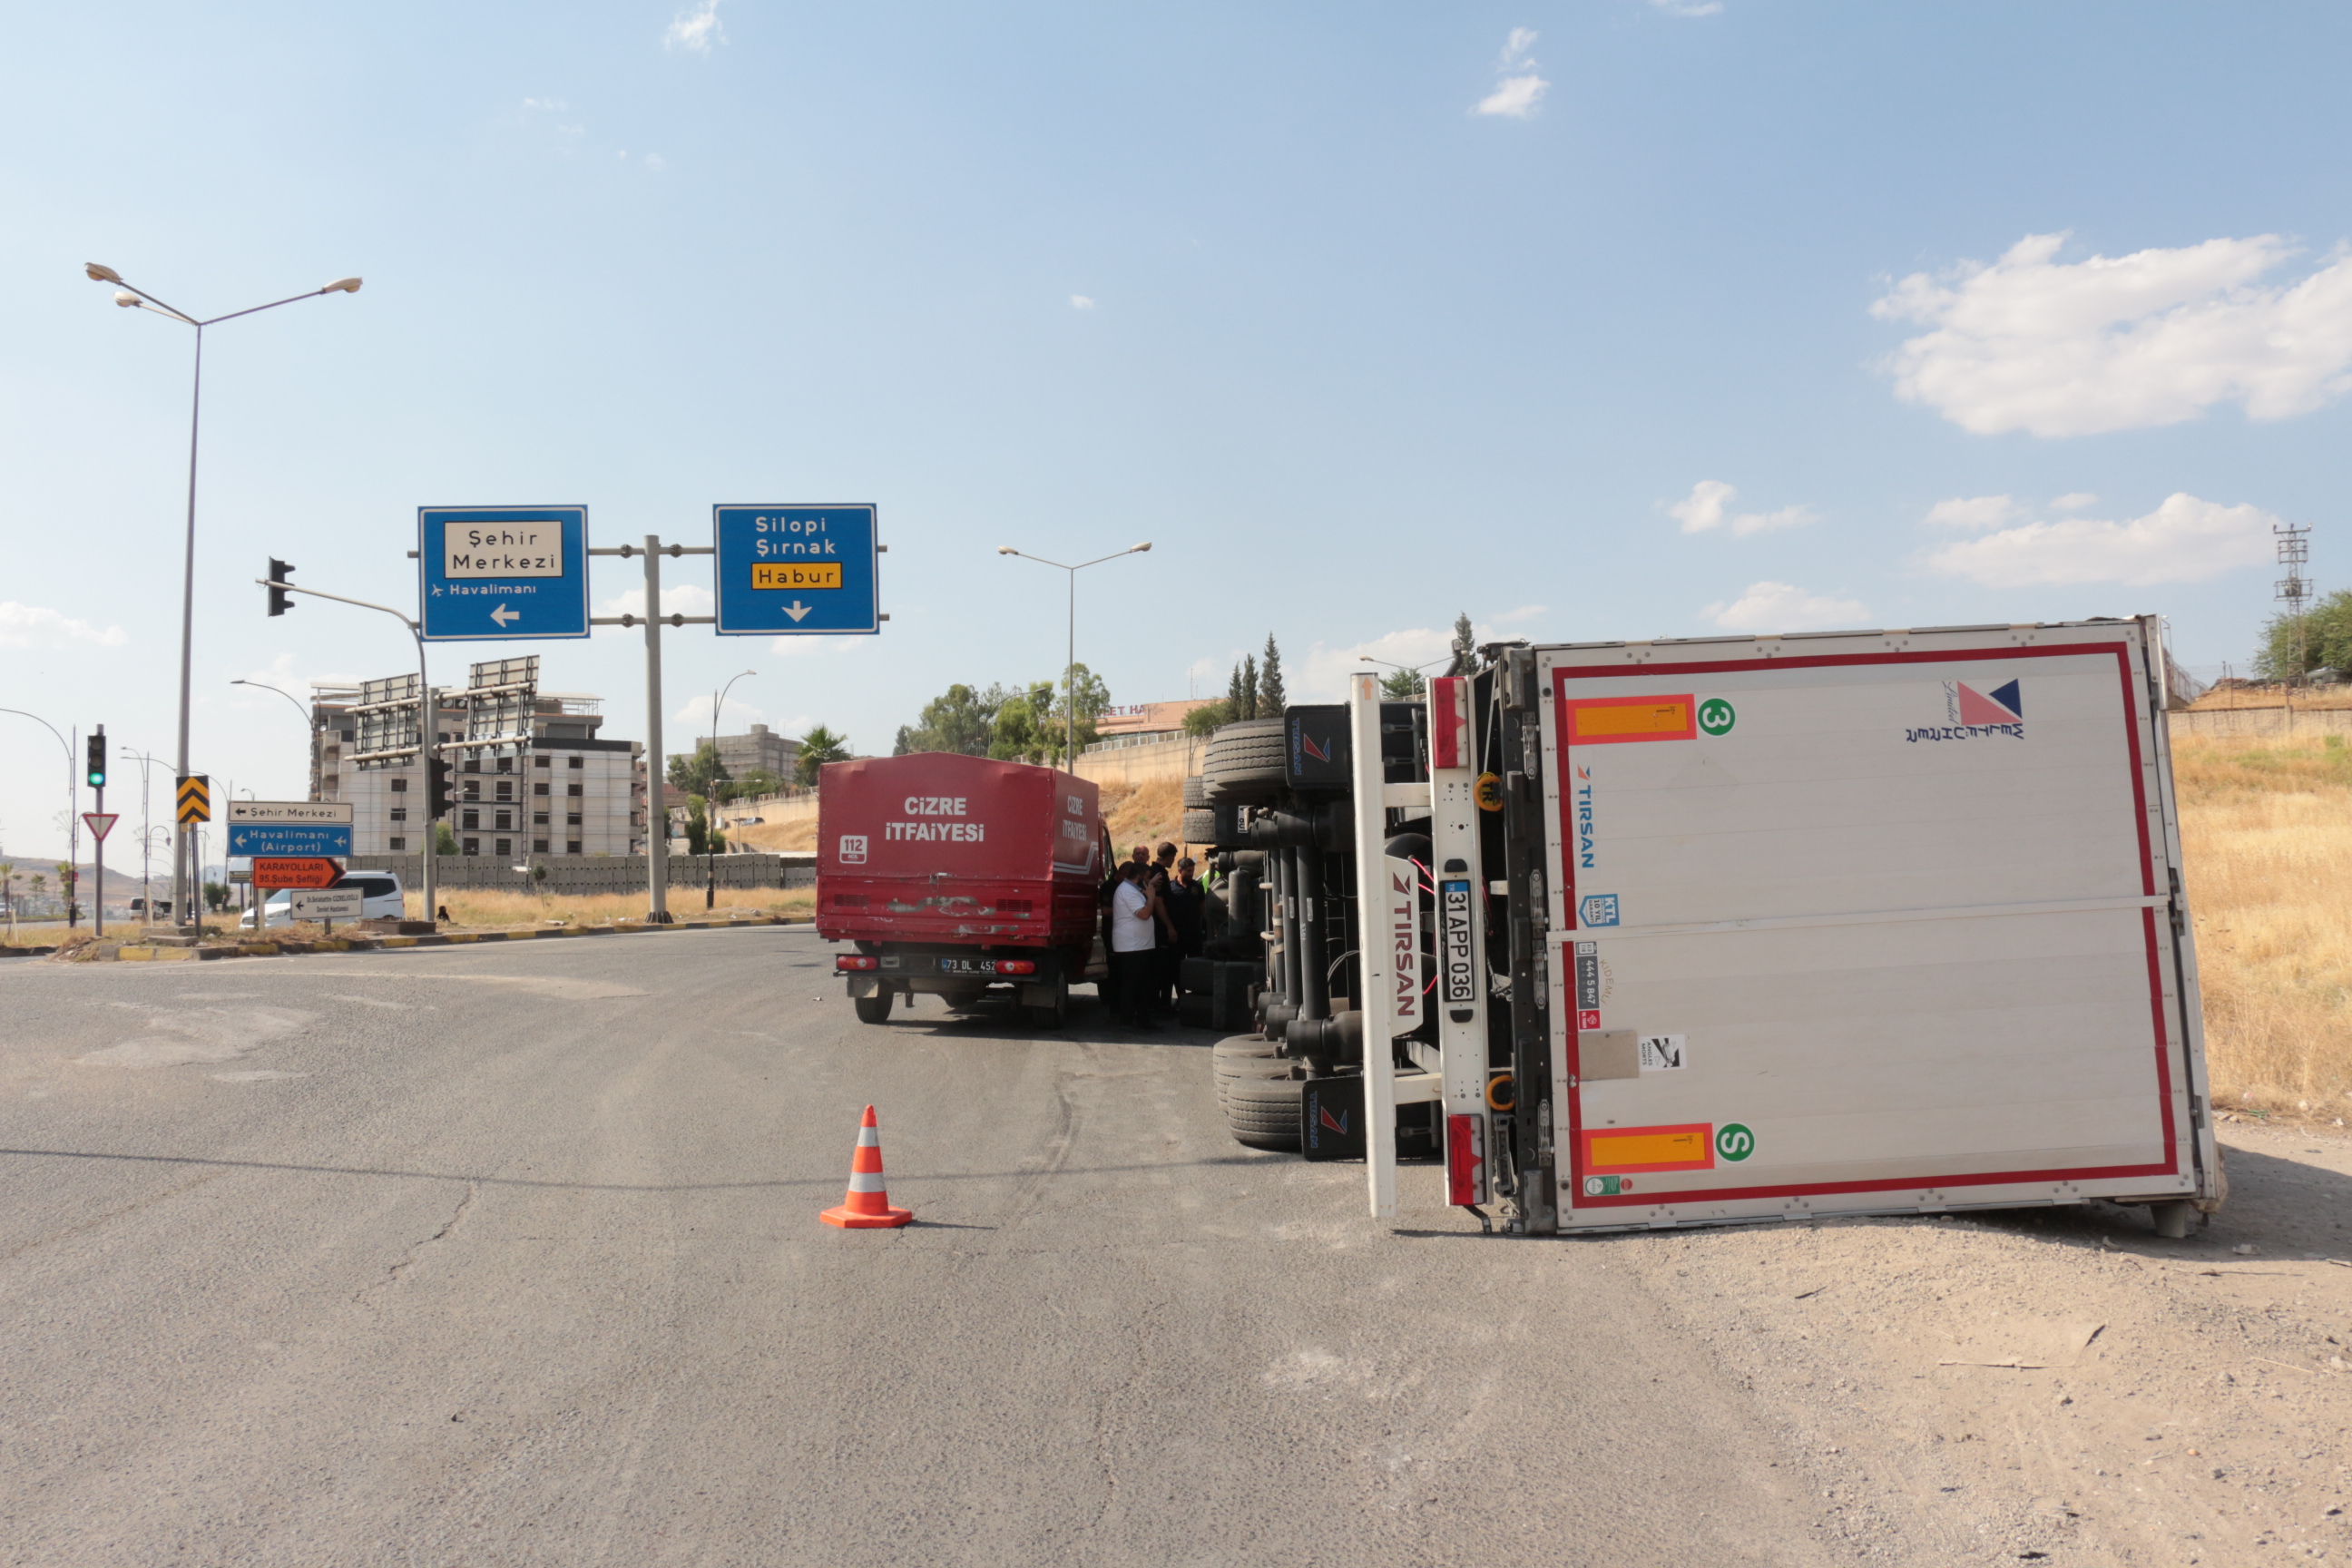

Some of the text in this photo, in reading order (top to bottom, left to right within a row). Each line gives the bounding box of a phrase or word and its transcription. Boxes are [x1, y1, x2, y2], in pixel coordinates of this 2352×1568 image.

[755, 515, 827, 534] Silopi
[468, 529, 538, 548] Şehir
[756, 538, 837, 556] Şırnak
[452, 553, 556, 570] Merkezi
[758, 567, 835, 584] Habur
[449, 583, 536, 595] Havalimanı
[1702, 707, 1731, 729] 3
[1292, 718, 1301, 776] TIRSAN
[250, 807, 337, 818] Şehir Merkezi
[250, 829, 329, 839] Havalimanı
[1578, 784, 1595, 868] TIRSAN
[261, 841, 321, 853] (Airport)
[844, 838, 863, 852] 112
[259, 862, 324, 872] KARAYOLLARI
[259, 874, 293, 885] 95.Şube
[296, 874, 323, 886] Şefliği
[330, 905, 349, 913] Hastanesi
[1593, 899, 1601, 908] 10
[1604, 897, 1616, 923] KTL
[1447, 893, 1470, 998] 31 APP 036
[946, 959, 996, 971] 73 DL 452
[1392, 900, 1416, 1017] TIRSAN
[1586, 960, 1595, 977] 444
[1586, 987, 1596, 1004] 847
[1310, 1091, 1318, 1149] TIRSAN
[1720, 1132, 1750, 1154] S
